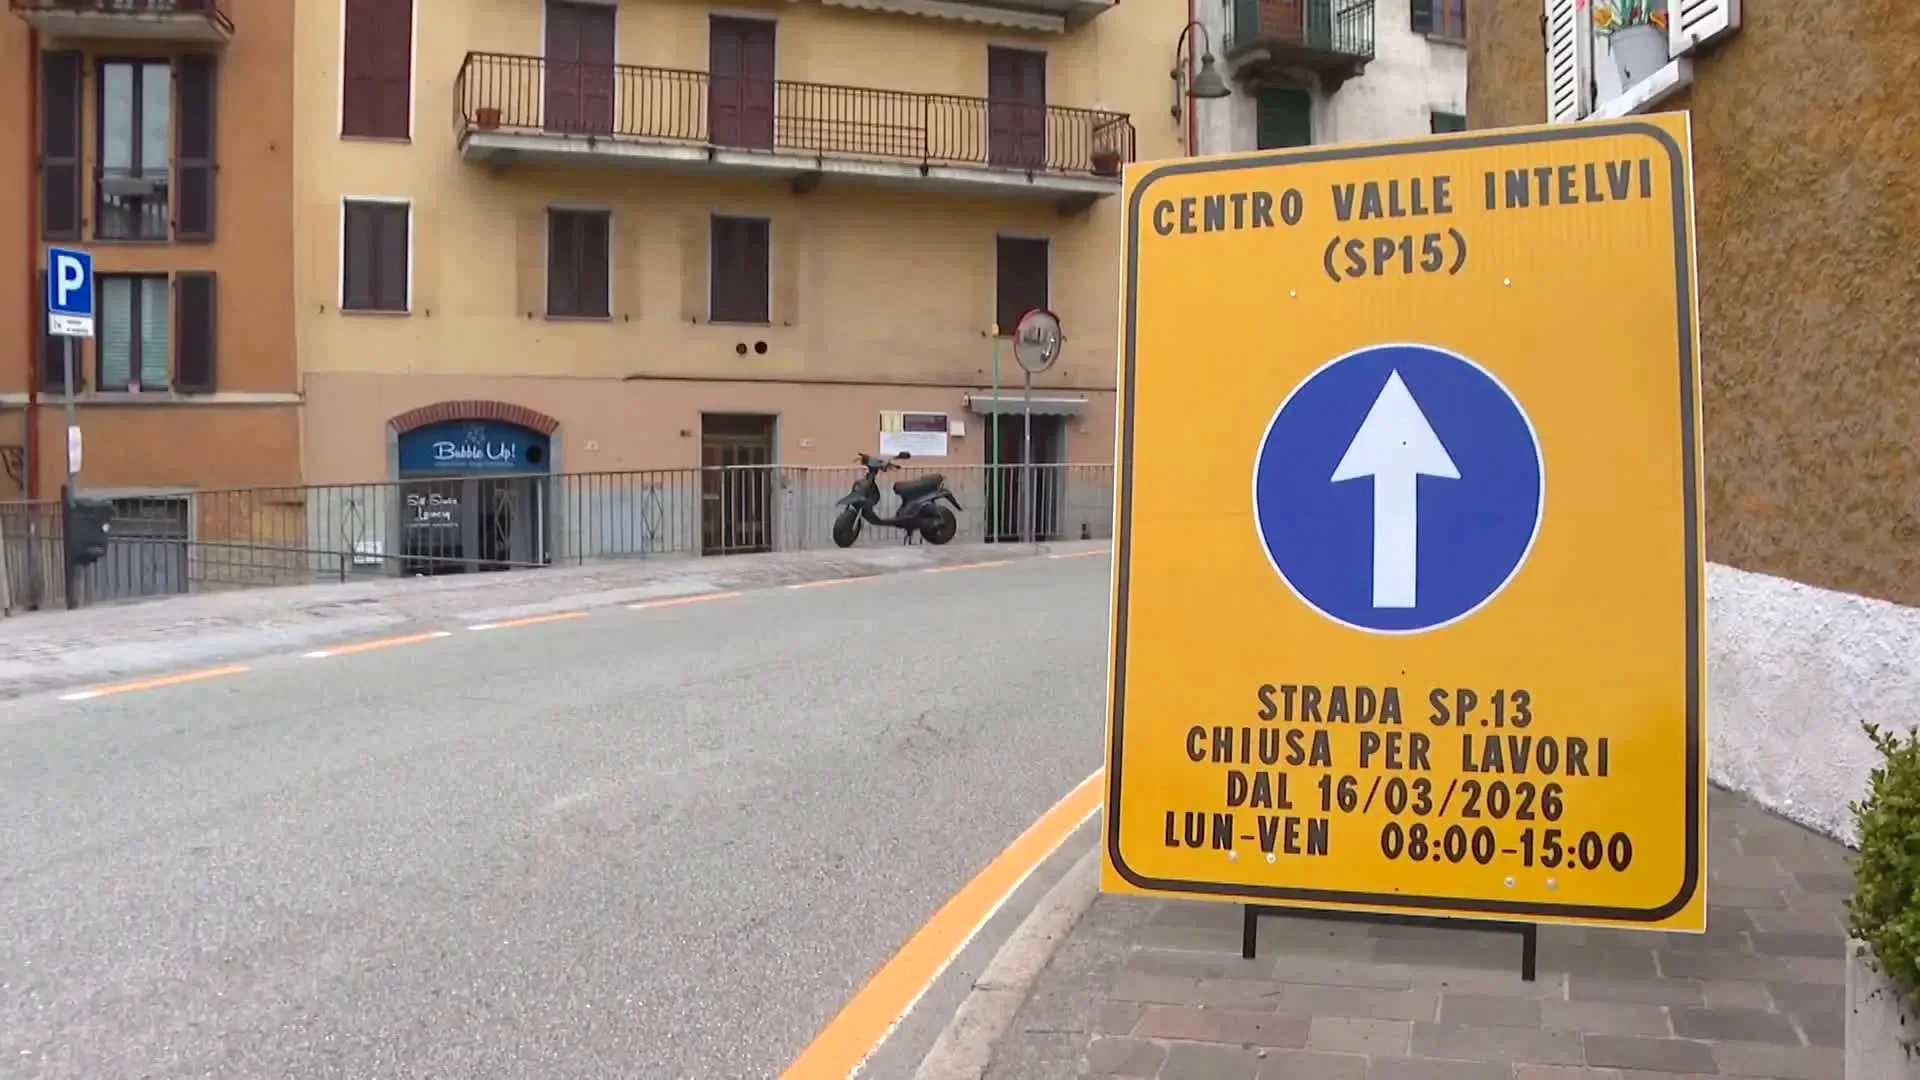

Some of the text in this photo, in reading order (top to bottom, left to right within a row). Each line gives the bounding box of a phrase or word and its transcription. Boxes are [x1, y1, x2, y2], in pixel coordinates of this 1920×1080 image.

[1152, 158, 1653, 237] CENTRO VALLE INTELVI
[57, 255, 85, 306] P
[1323, 228, 1467, 283] (SP15)
[431, 441, 516, 462] Bubble Up!
[1257, 683, 1533, 729] STRADA SP.13
[1186, 725, 1609, 778] CHIUSA PER LAVORI
[1226, 769, 1564, 824] DAL 16/03/2026
[1164, 810, 1634, 874] LUN-VEN 08:00-15:00
